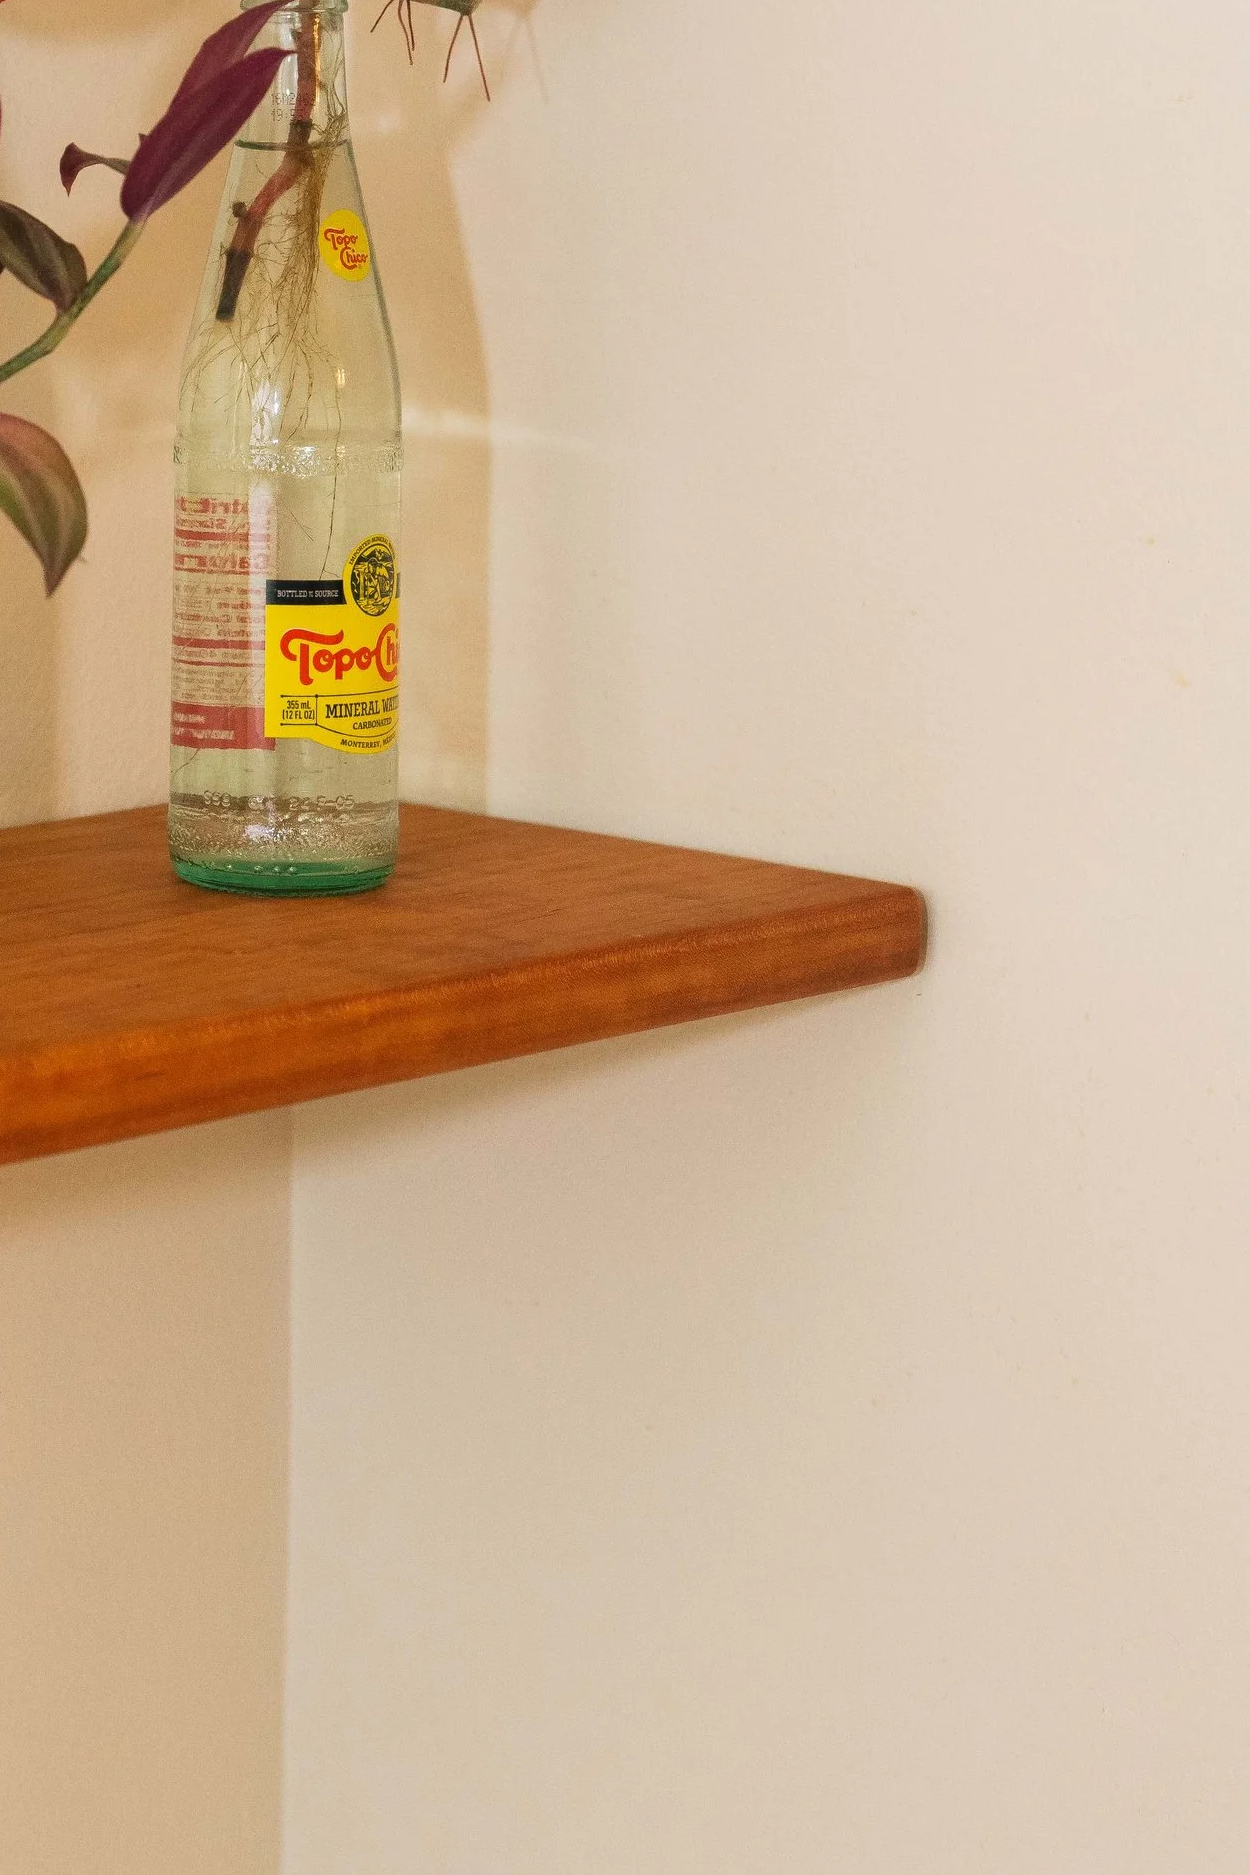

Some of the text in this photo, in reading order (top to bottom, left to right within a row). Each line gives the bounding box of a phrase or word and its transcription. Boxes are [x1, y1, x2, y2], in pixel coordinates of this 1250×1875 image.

[324, 228, 358, 250] Topo
[340, 246, 368, 270] Chico
[277, 589, 308, 598] BOTTLED
[314, 589, 339, 598] SOURCE
[280, 629, 372, 686] Topo
[286, 700, 300, 710] 355
[325, 699, 380, 719] MINERAL
[294, 710, 303, 720] FL
[352, 717, 393, 731] CARBONATED
